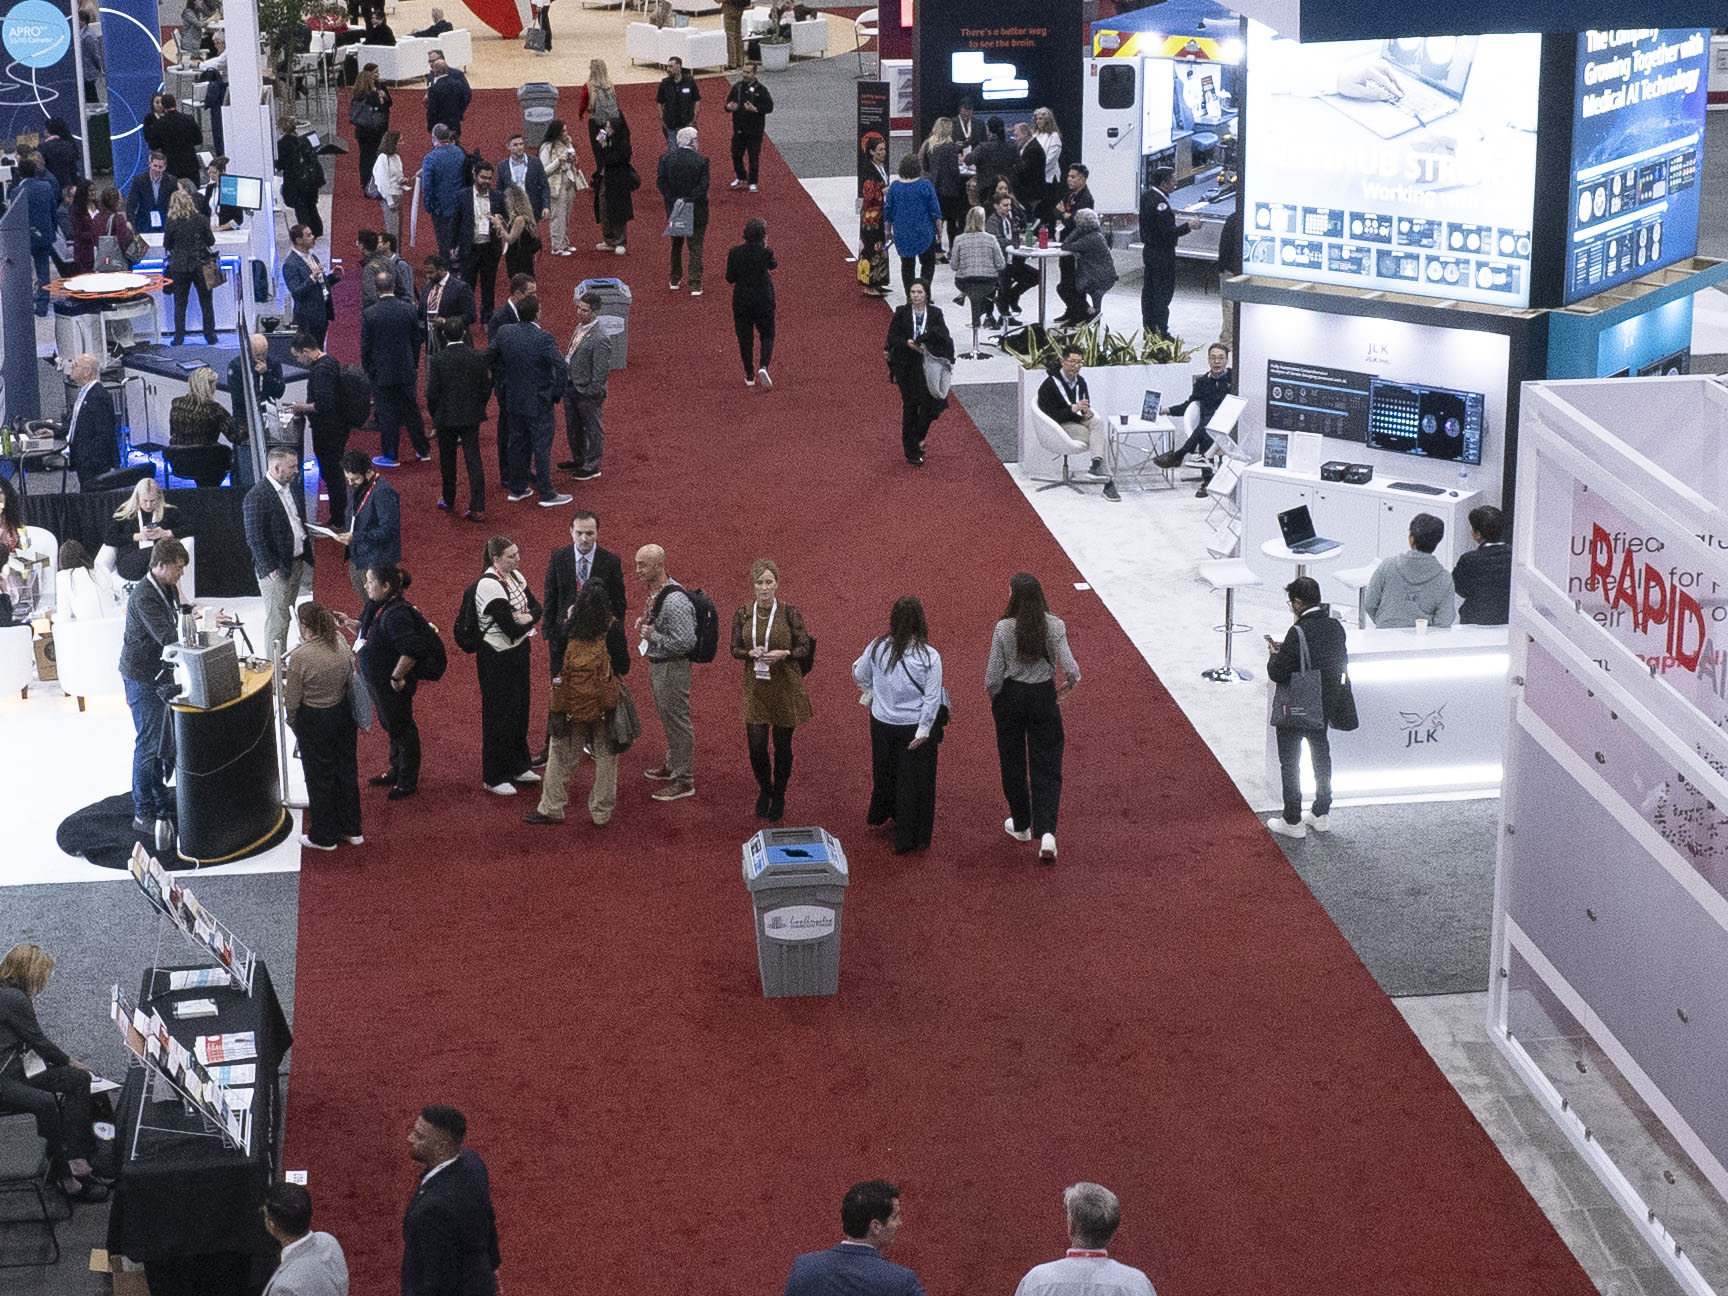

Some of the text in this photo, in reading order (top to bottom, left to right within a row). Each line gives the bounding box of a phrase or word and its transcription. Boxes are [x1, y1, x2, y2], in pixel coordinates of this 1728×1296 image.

[1586, 28, 1608, 53] The
[1583, 30, 1704, 87] Growing Together with
[1582, 64, 1702, 120] Medical AI Technology
[1367, 342, 1390, 356] JLK
[1405, 727, 1440, 749] JLK
